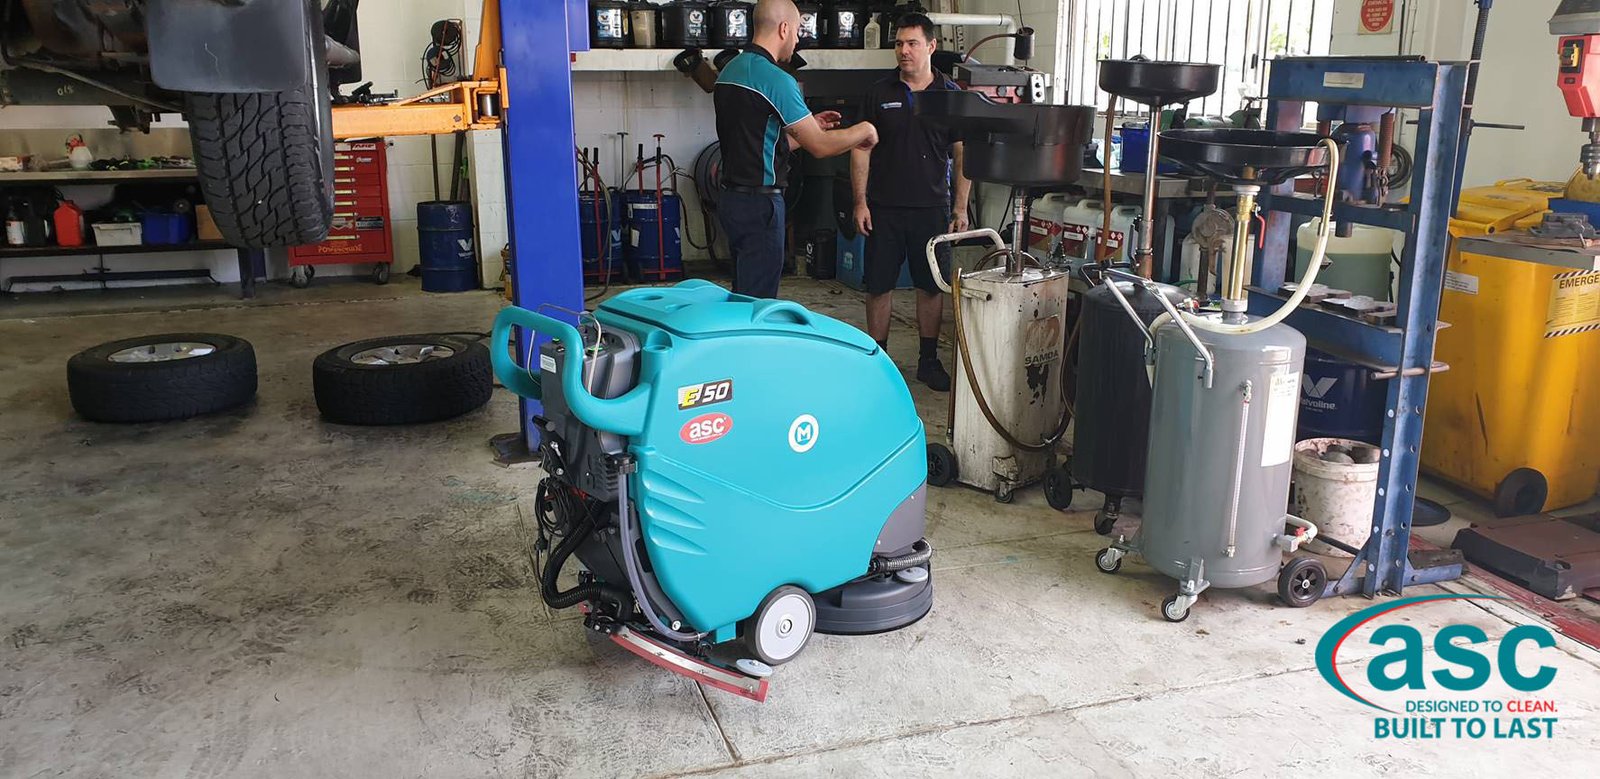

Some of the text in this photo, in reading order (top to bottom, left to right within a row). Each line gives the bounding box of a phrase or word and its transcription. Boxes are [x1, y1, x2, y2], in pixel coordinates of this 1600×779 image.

[1559, 274, 1600, 289] EMERGE
[1024, 350, 1059, 365] SAMOA
[1300, 398, 1336, 410] alvoline
[689, 417, 725, 439] asc
